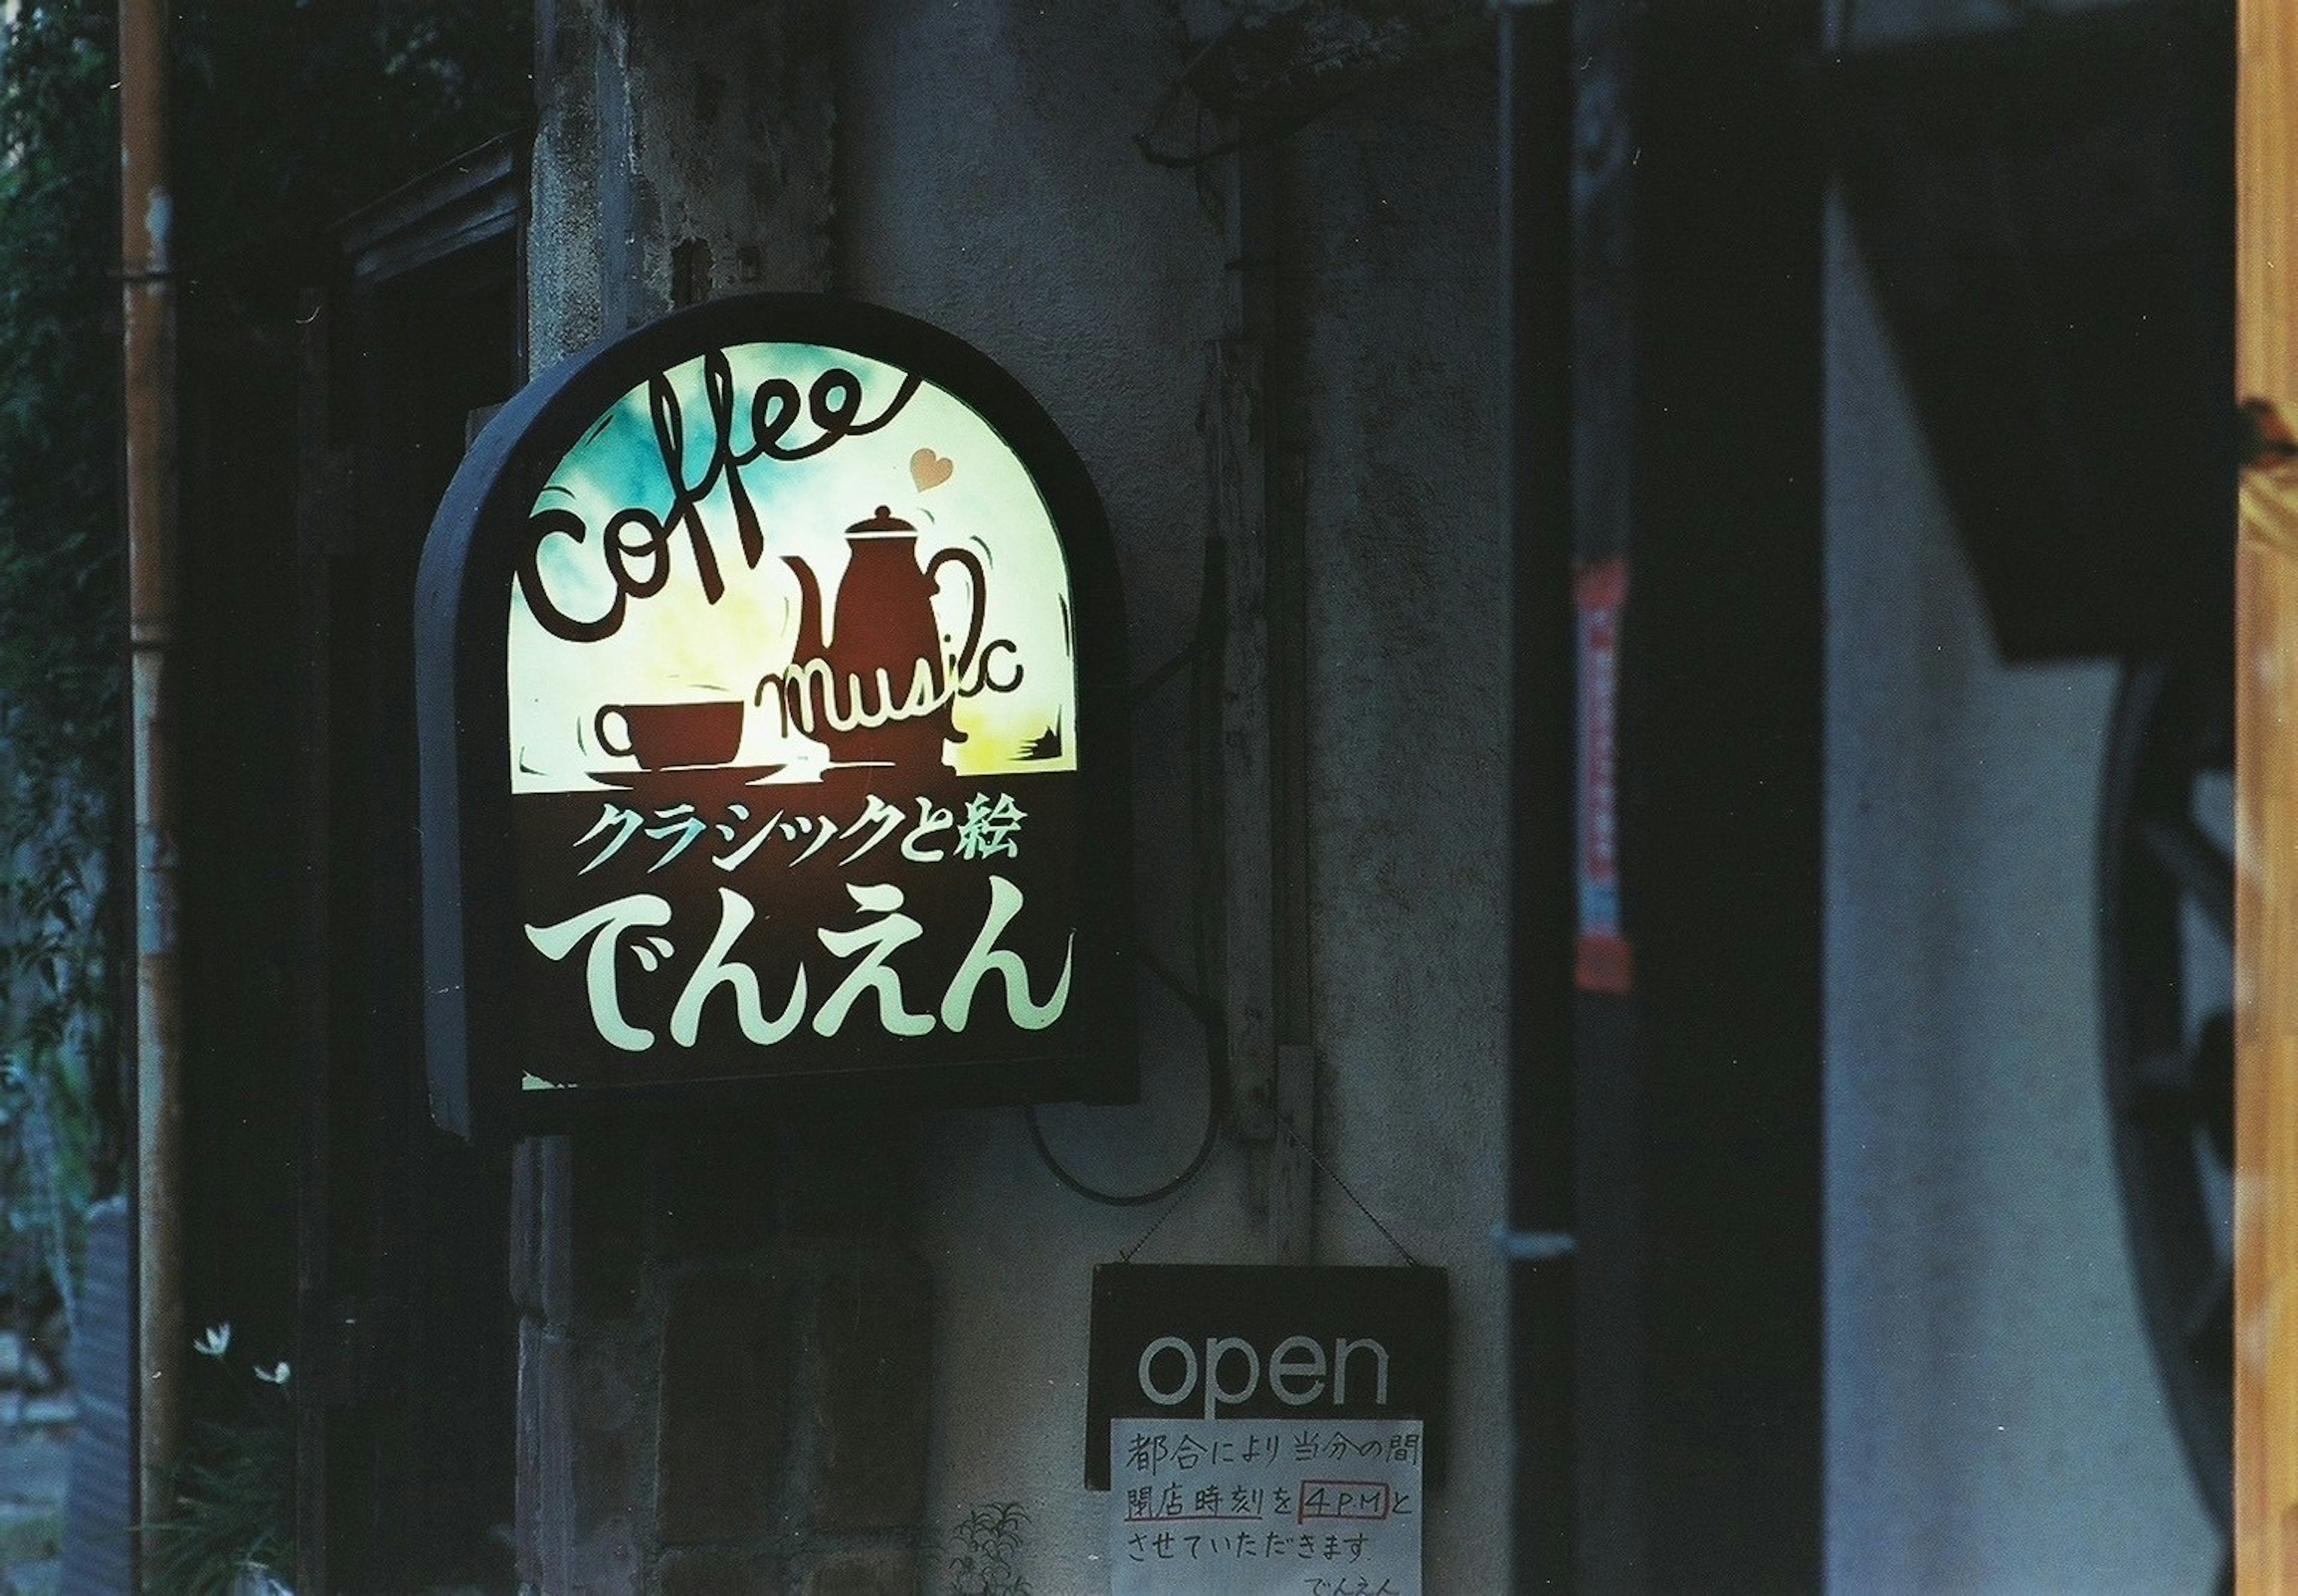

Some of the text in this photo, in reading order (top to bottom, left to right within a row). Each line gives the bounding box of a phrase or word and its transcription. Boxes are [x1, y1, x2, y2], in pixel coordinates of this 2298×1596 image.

[515, 348, 924, 643] coffee
[754, 634, 1024, 739] music
[572, 791, 1028, 876] クラシックと絵
[524, 875, 1076, 1052] でんえん
[1138, 1335, 1390, 1419] open
[1126, 1431, 1420, 1475] 都合により当分の間
